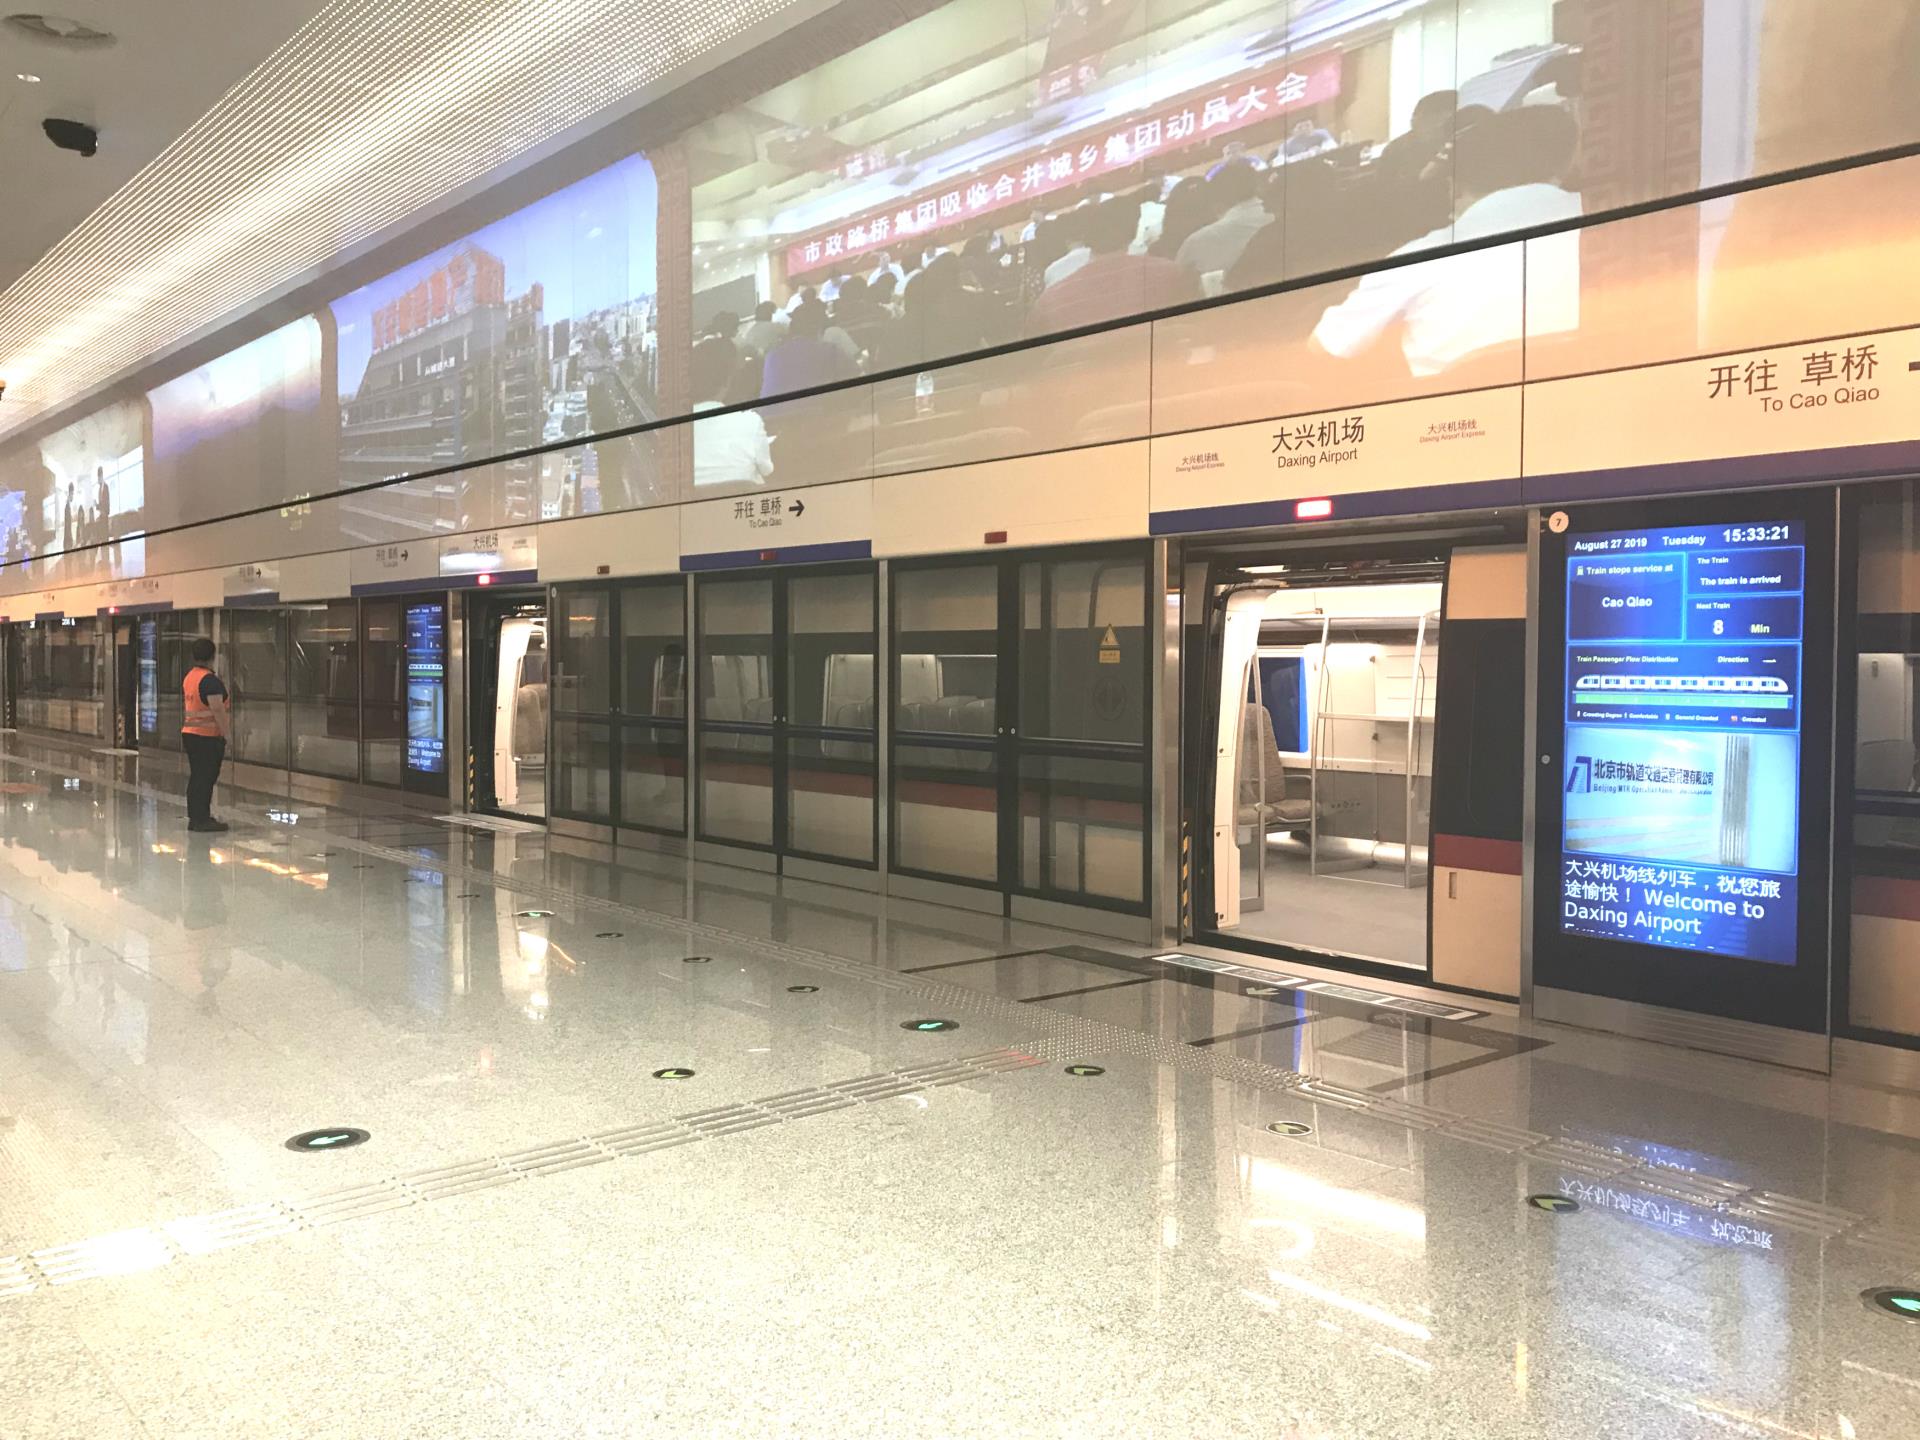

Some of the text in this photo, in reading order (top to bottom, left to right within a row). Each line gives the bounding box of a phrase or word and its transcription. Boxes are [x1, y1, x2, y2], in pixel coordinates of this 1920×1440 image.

[1708, 344, 1879, 399] 开往 草桥
[1760, 386, 1880, 412] To Cao Qiao
[1272, 416, 1365, 453] 大兴机场
[1278, 448, 1358, 468] Daxing Airport
[760, 496, 782, 516] 草桥
[1662, 535, 1706, 546] Tuesday
[1723, 525, 1789, 542] 15:33:21
[1574, 538, 1648, 552] August 27 2019
[1712, 556, 1729, 564] Train
[1587, 563, 1673, 575] Train stops service at
[1700, 575, 1781, 586] The train is arrived
[1602, 596, 1653, 607] Cao Qiao
[1713, 619, 1724, 635] 8
[1750, 624, 1770, 634] Min
[1644, 888, 1736, 915] Welcome
[1743, 900, 1765, 919] to
[1565, 901, 1702, 935] Daxing Airport
